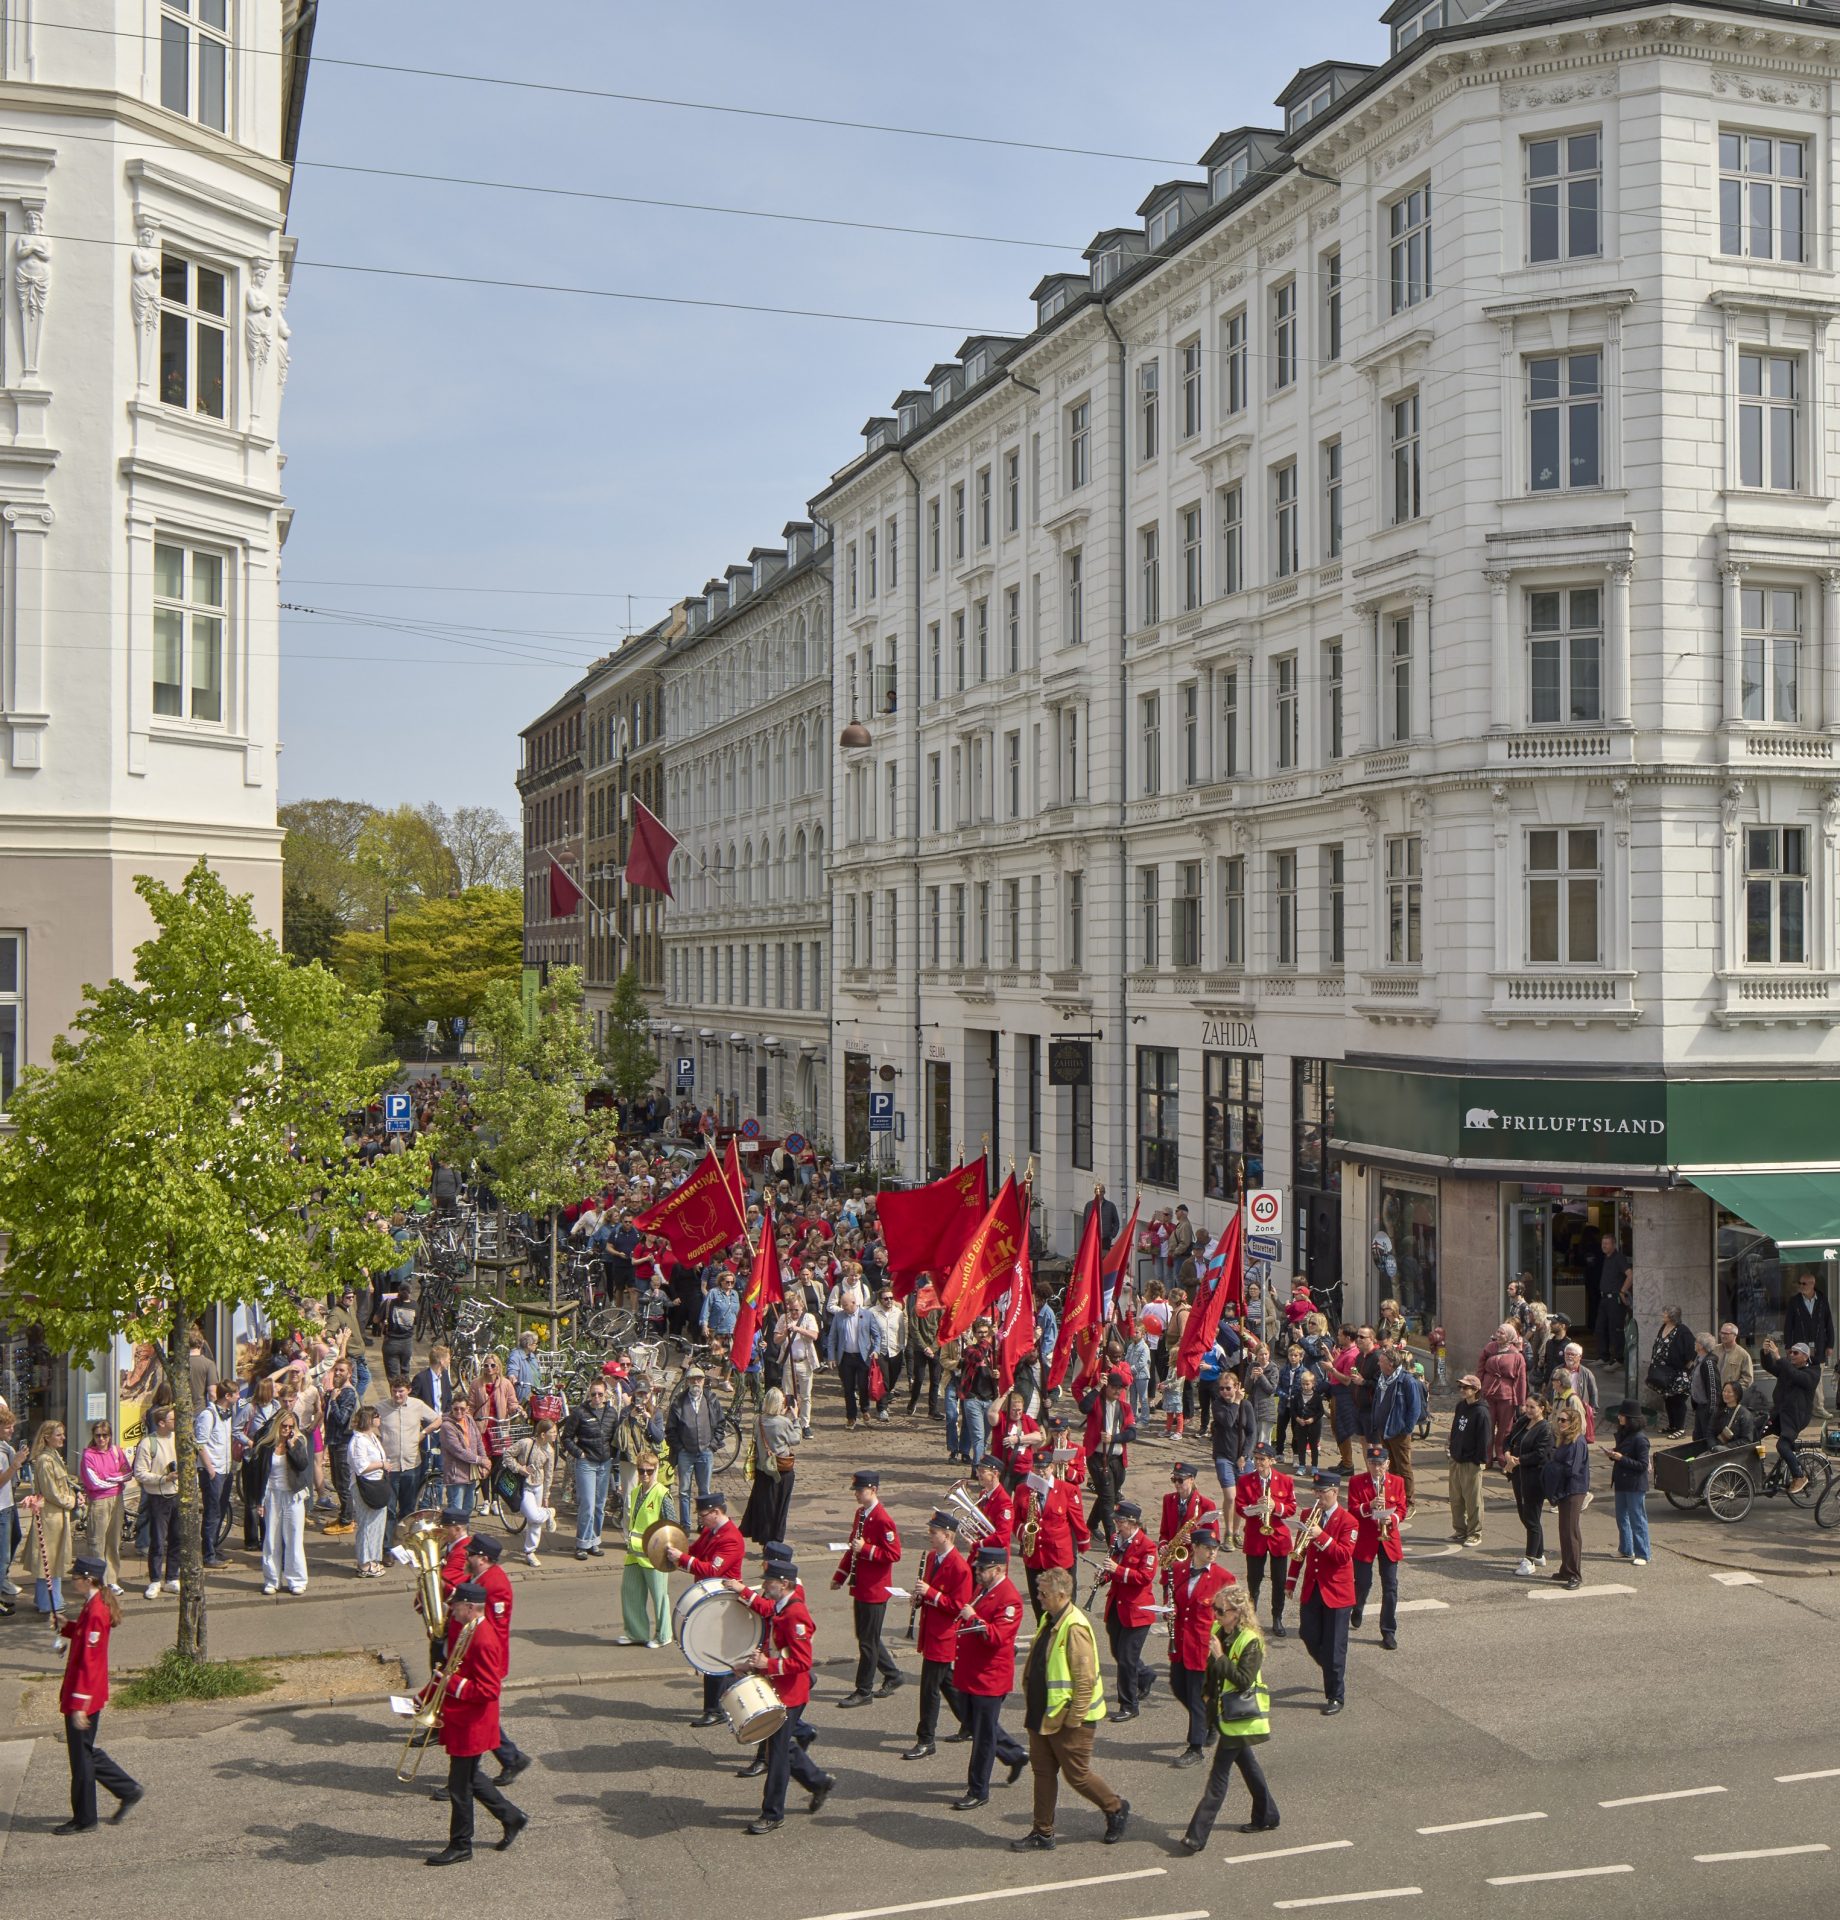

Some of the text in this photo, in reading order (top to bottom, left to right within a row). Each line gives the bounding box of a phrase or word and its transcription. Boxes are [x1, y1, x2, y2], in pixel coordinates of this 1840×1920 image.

[1202, 1022, 1258, 1048] ZAHIDA
[930, 1045, 946, 1058] SELMA
[680, 1060, 690, 1074] P
[1054, 1058, 1084, 1068] ZAHIDA
[392, 1098, 406, 1116] P
[876, 1096, 888, 1114] P
[1502, 1116, 1664, 1134] FRILUFTSLAND
[665, 1170, 720, 1216] KOMMUNAL
[1256, 1202, 1274, 1214] 40
[985, 1235, 1017, 1266] HK
[1252, 1242, 1274, 1254] Ensrettet
[647, 1500, 654, 1510] A
